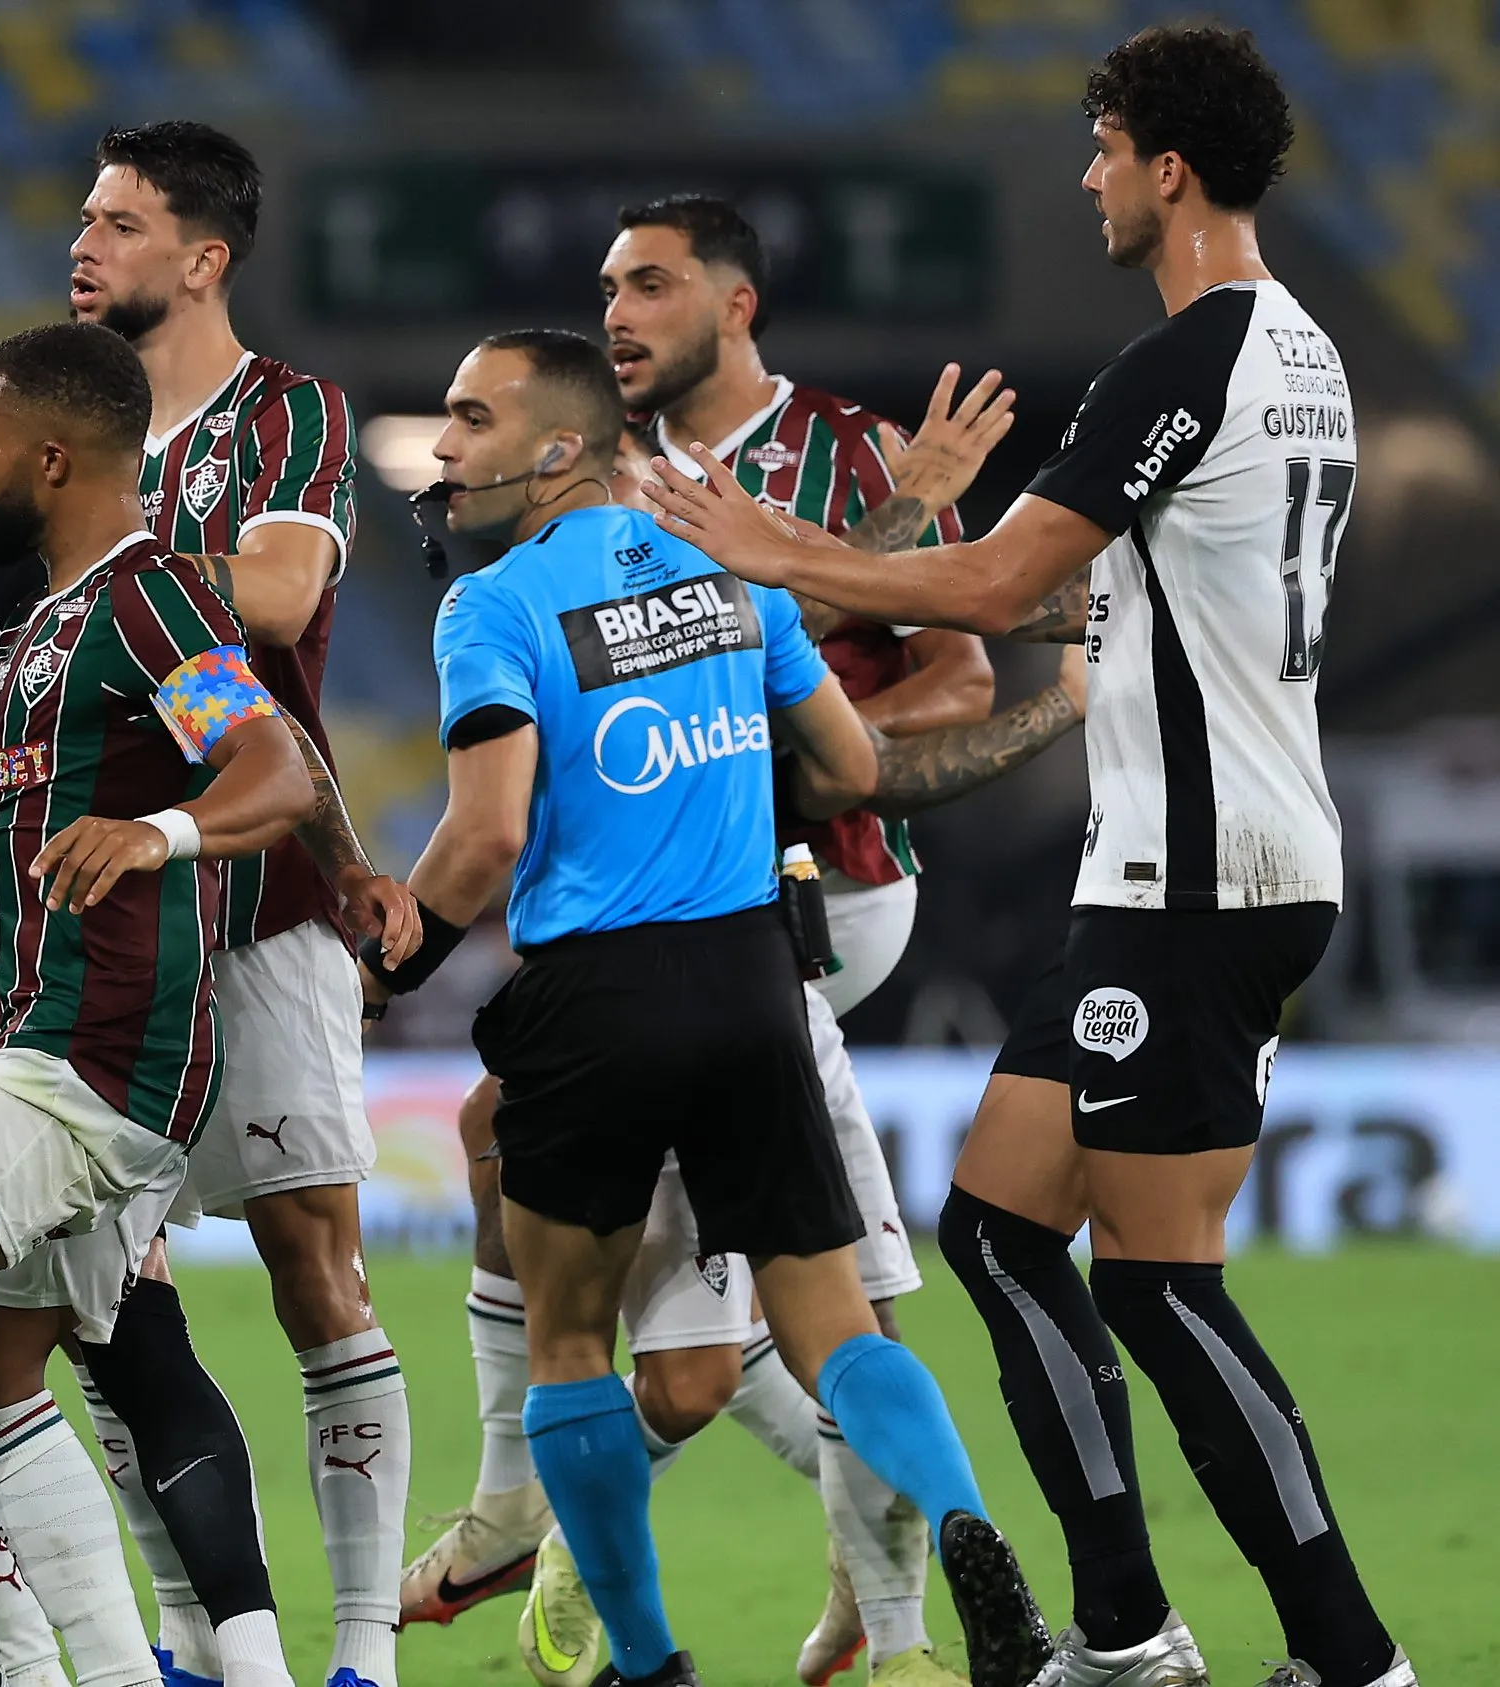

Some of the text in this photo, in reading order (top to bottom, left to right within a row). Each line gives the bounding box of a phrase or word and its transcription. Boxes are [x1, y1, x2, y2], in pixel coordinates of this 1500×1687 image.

[1284, 373, 1345, 398] SEGURO AUTO
[1142, 413, 1169, 448] banco
[1261, 403, 1347, 442] GUSTAVO
[1134, 407, 1201, 482] bmg
[614, 541, 654, 567] CBF
[593, 580, 735, 646] BRASIL
[652, 631, 683, 649] COPA
[683, 624, 703, 639] DO
[634, 705, 769, 783] Midea
[1082, 1000, 1137, 1020] Broto
[1083, 1017, 1140, 1045] Legal
[319, 1422, 383, 1448] FFC
